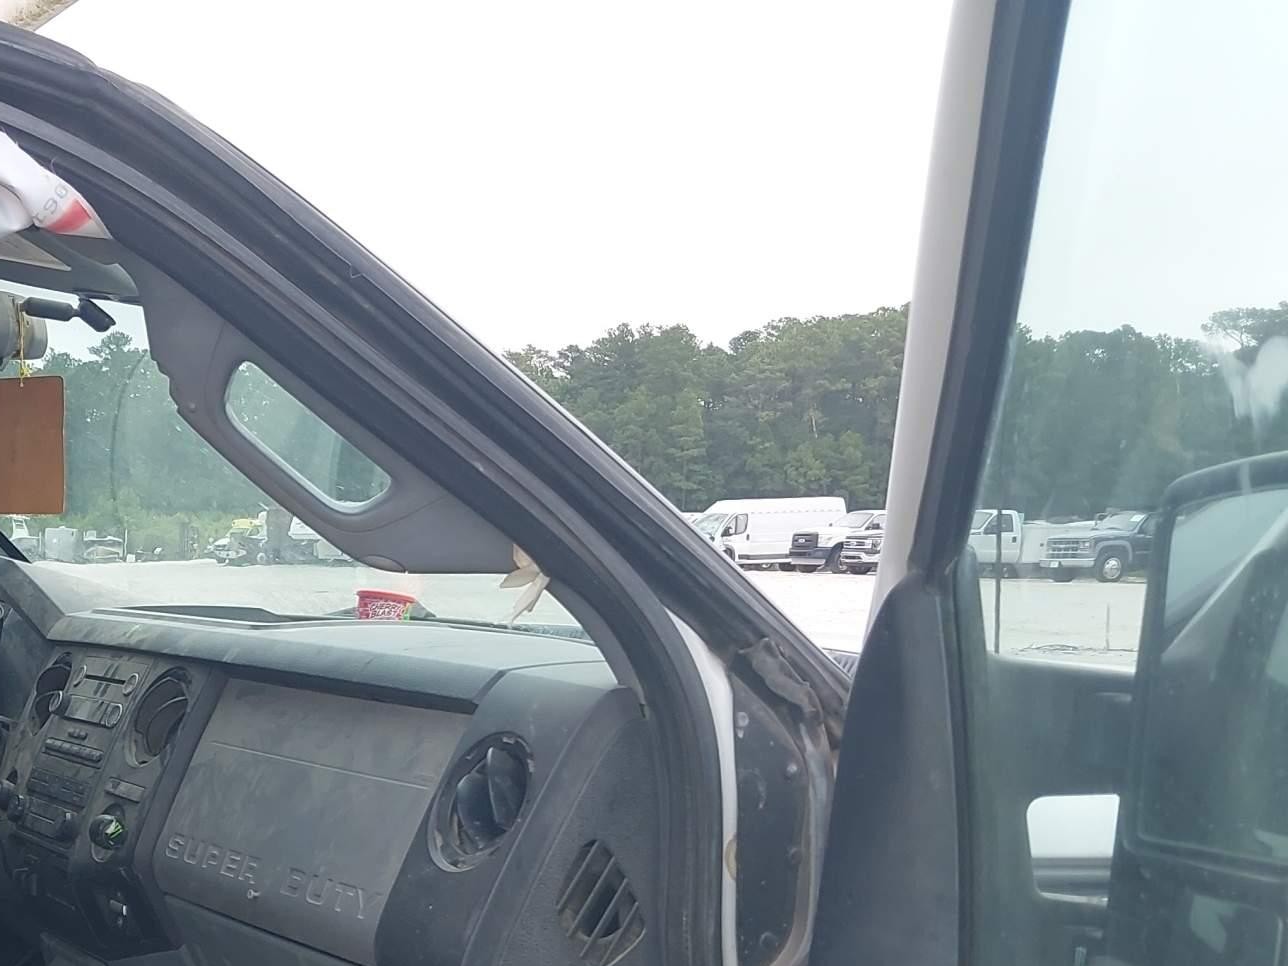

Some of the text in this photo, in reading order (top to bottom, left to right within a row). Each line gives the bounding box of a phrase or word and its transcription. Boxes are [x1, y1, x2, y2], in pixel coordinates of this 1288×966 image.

[370, 602, 401, 611] CHERRY
[371, 608, 397, 618] BLAST
[164, 832, 384, 920] SUPER DUTY
